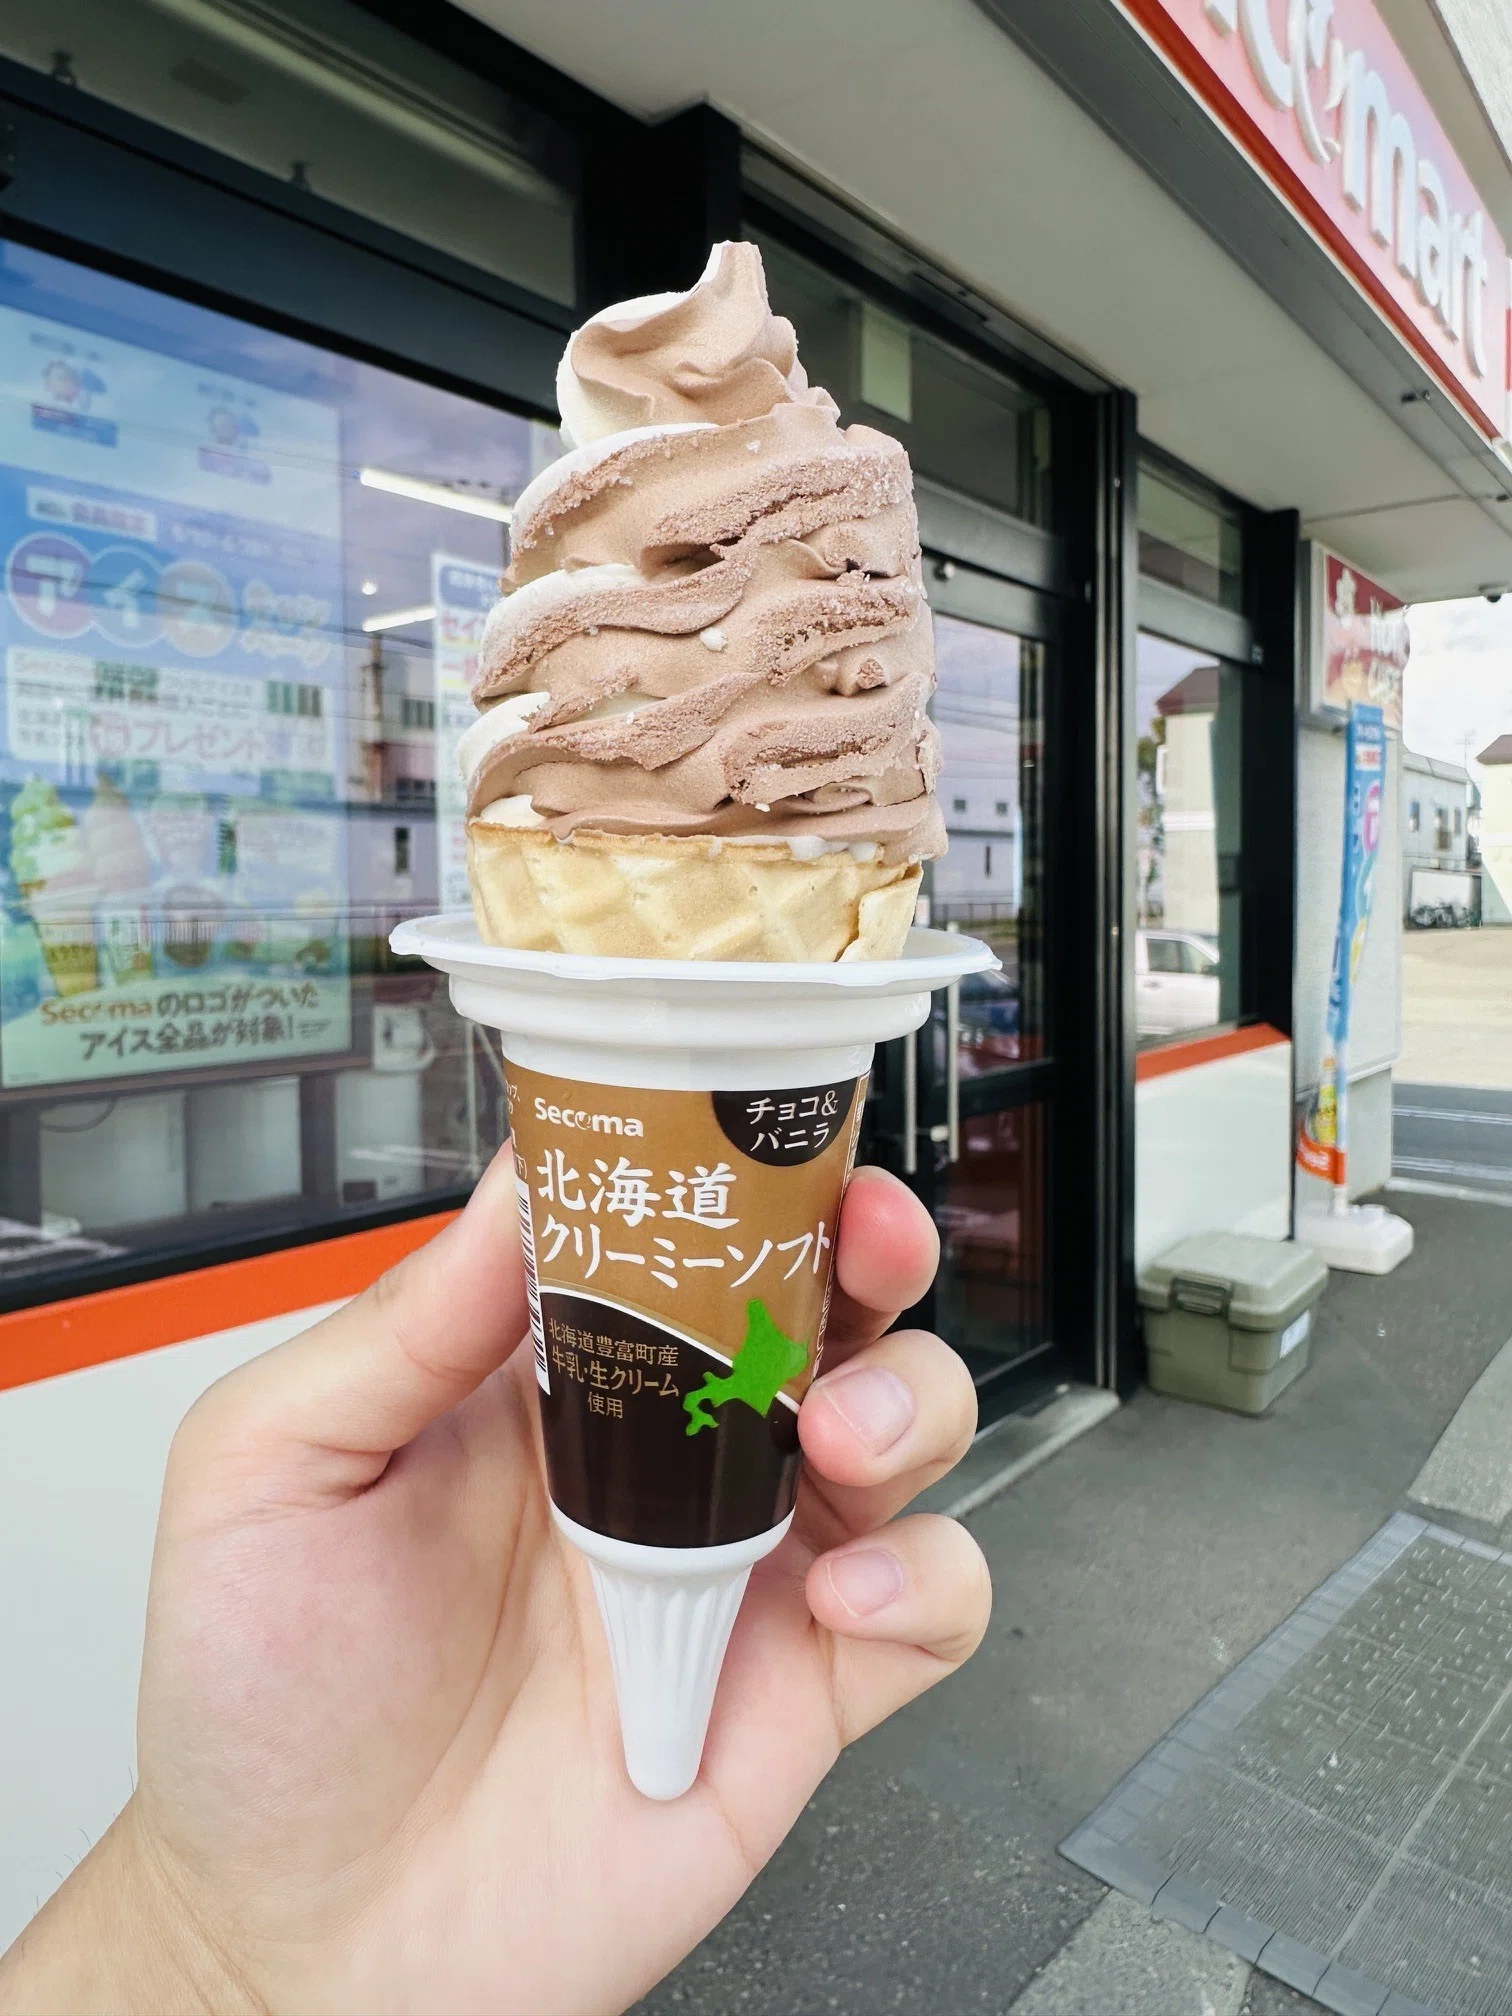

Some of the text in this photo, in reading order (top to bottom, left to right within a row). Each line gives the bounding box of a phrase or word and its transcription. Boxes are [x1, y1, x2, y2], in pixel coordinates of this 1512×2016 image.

[534, 1097, 644, 1137] Secoma
[746, 1090, 839, 1125] チョコ&
[750, 1122, 830, 1151] バニラ
[536, 1149, 740, 1230] 北海道
[541, 1214, 830, 1289] クリーミーソフト
[549, 1317, 679, 1367] 北海道豊富町産
[587, 1391, 623, 1419] 使用
